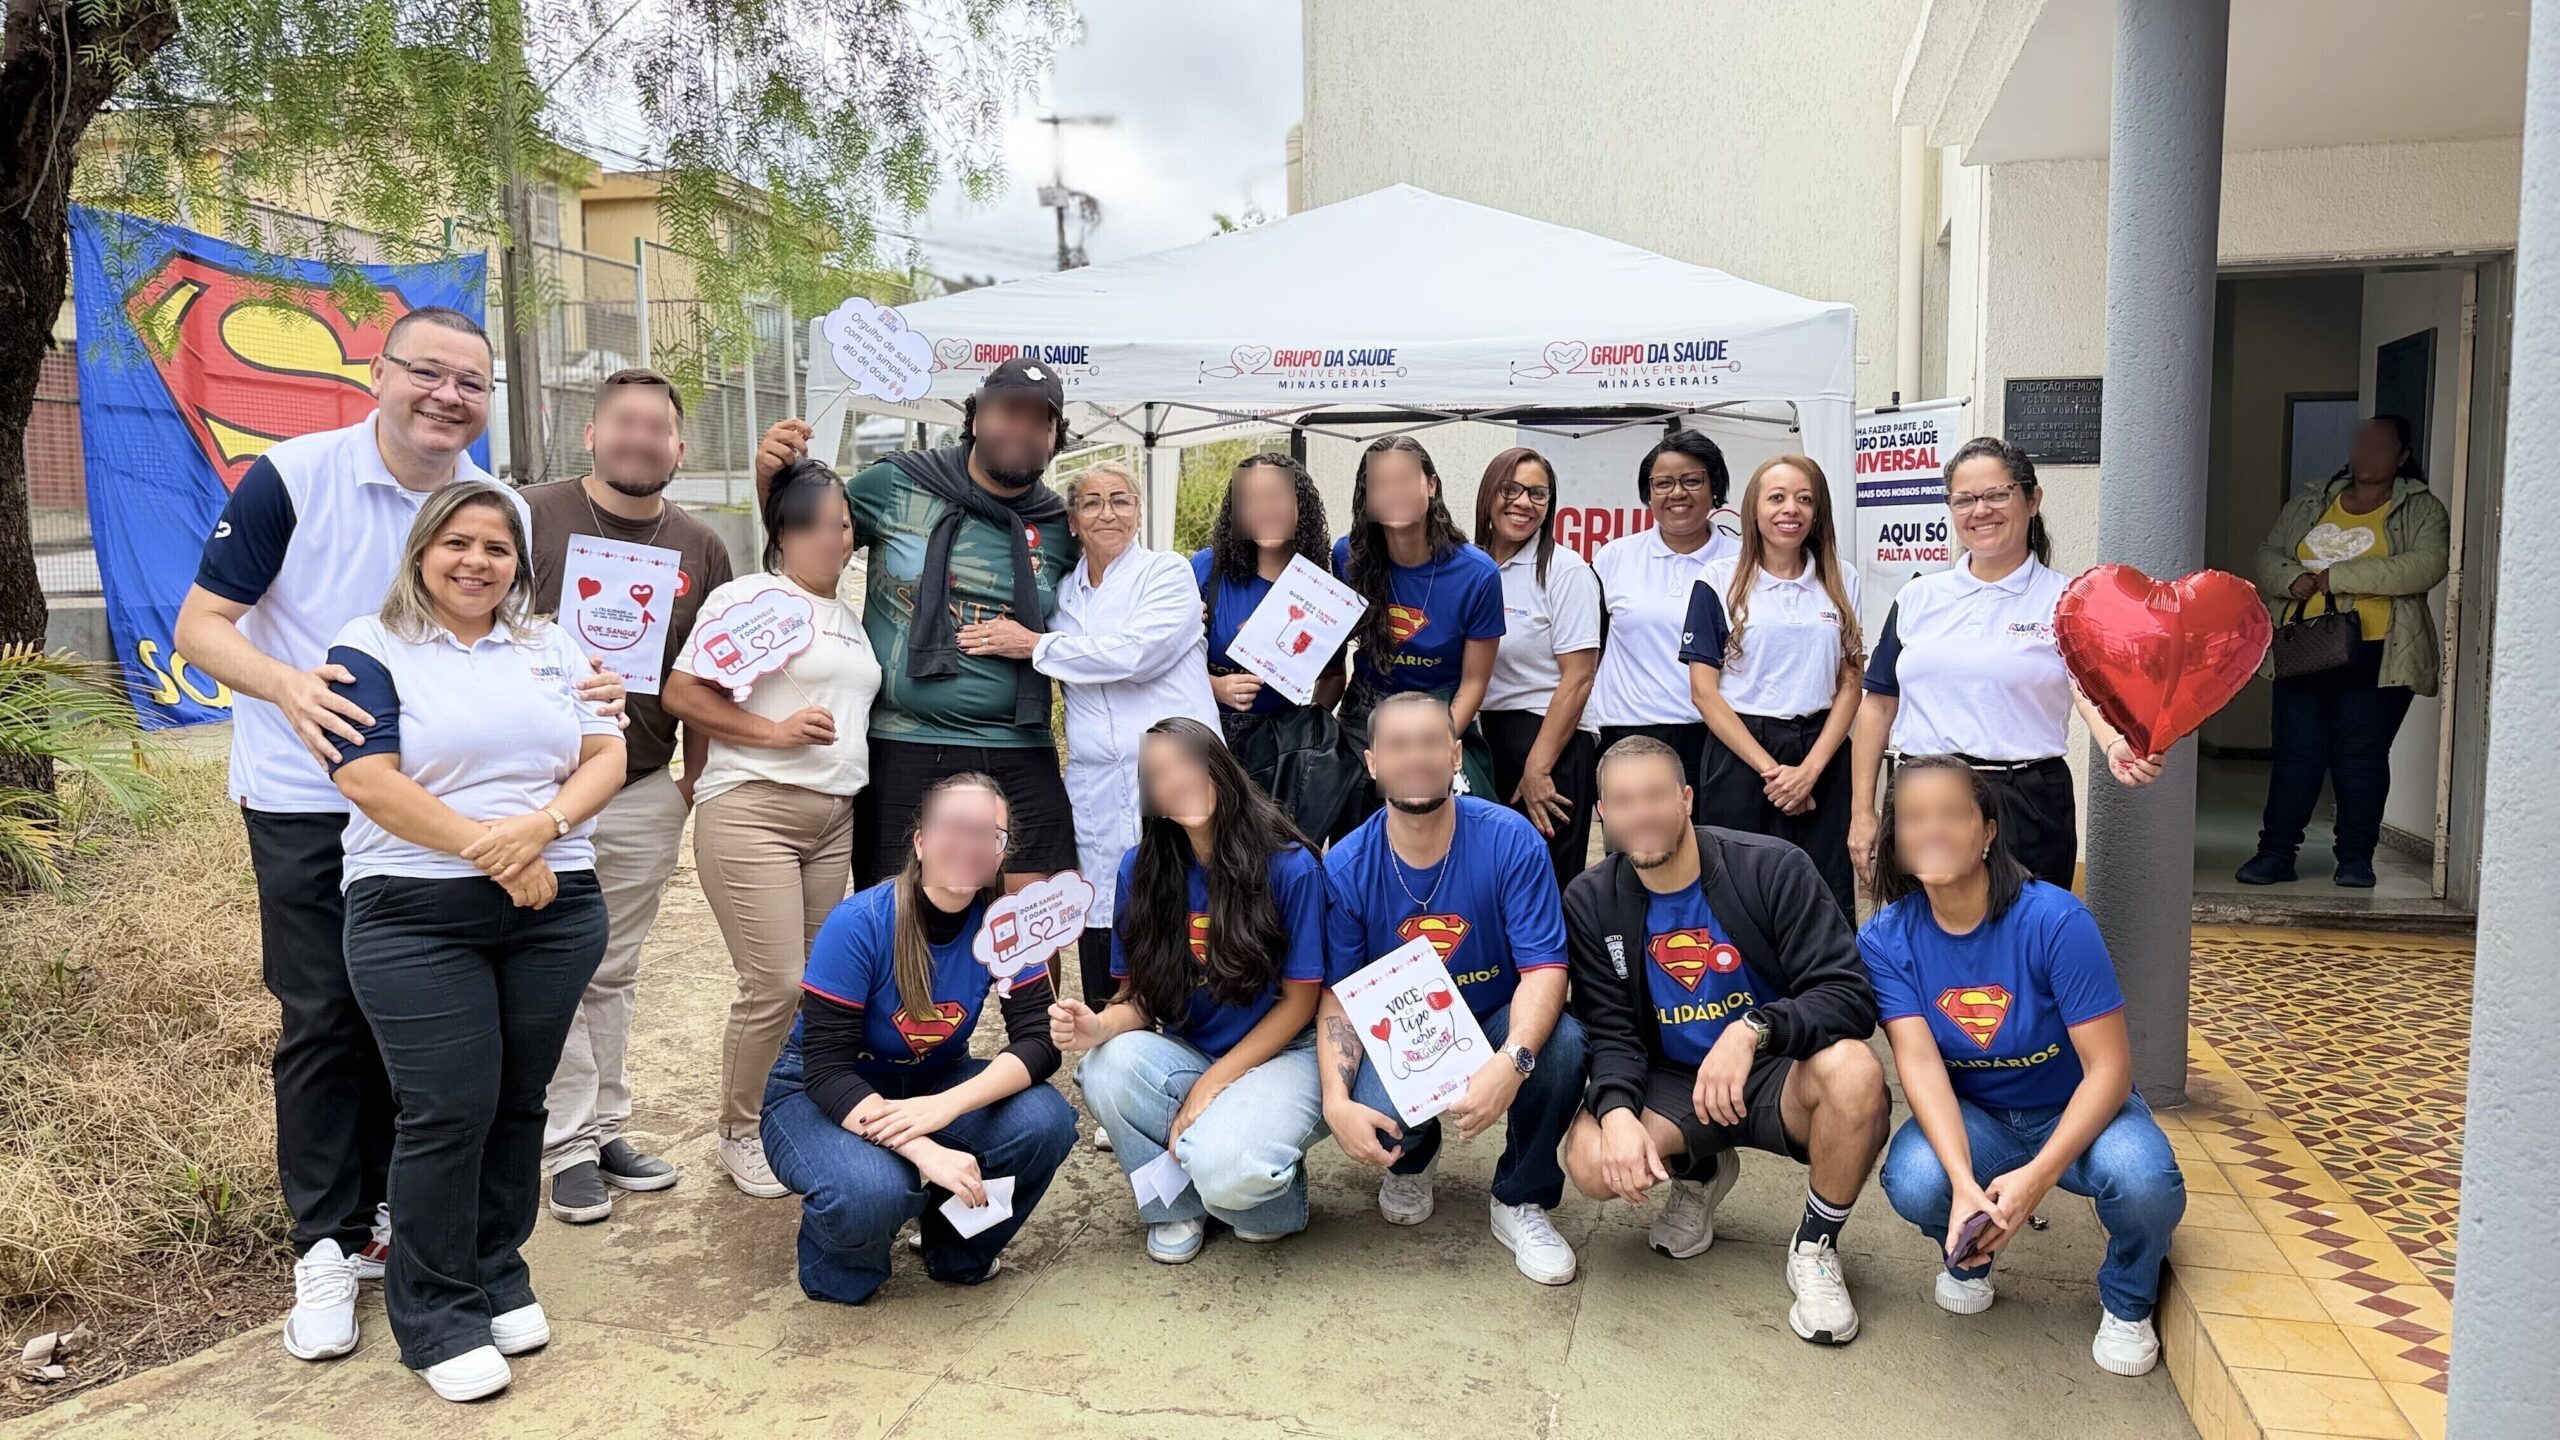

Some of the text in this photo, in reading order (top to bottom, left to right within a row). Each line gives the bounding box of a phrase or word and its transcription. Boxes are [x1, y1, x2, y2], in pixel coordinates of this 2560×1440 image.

[851, 312, 921, 376] Orgulho de salvar
[1591, 337, 1729, 366] GRUPO DA SAÚDE
[843, 325, 909, 383] com um simples
[975, 342, 1089, 365] GRUPO DA SAÚDE
[1273, 346, 1397, 367] GRUPO DA SAÚDE
[842, 342, 890, 385] ato de doar
[1288, 367, 1378, 378] UNIVERSAL
[1608, 363, 1709, 376] UNIVERSAL
[1278, 379, 1387, 389] MINAS GERAIS
[1598, 375, 1719, 388] MINAS GERAIS
[2010, 381, 2101, 392] FUNDAÇÃO HEMOM
[2021, 404, 2102, 415] JÚLIA KUBITSCHE
[1855, 420, 1934, 436] HA FAZER PARTE DO
[1855, 436, 1877, 451] UPO
[1880, 435, 1898, 448] DA
[1858, 485, 1946, 499] MAIS DOS NOSSOS PROJET
[1879, 516, 1948, 547] AQUI SÓ
[1877, 544, 1949, 561] FALTA VOCÊ!
[1289, 590, 1304, 602] QUEM
[1301, 604, 1314, 614] DOA
[732, 606, 775, 635] DOAR SANGUE
[744, 623, 763, 637] DOAR
[762, 615, 779, 626] VIDA
[587, 624, 603, 633] DOE
[606, 627, 638, 637] SANGUE
[1389, 651, 1443, 668] ÁRIOS
[1020, 890, 1064, 915] DOAR SANGUE
[1028, 907, 1048, 920] DOAR
[1048, 900, 1063, 911] VIDA
[1385, 986, 1423, 1015] VOCÊ
[1653, 992, 1754, 1024] LIDÁRIOS
[1412, 1026, 1437, 1045] certo
